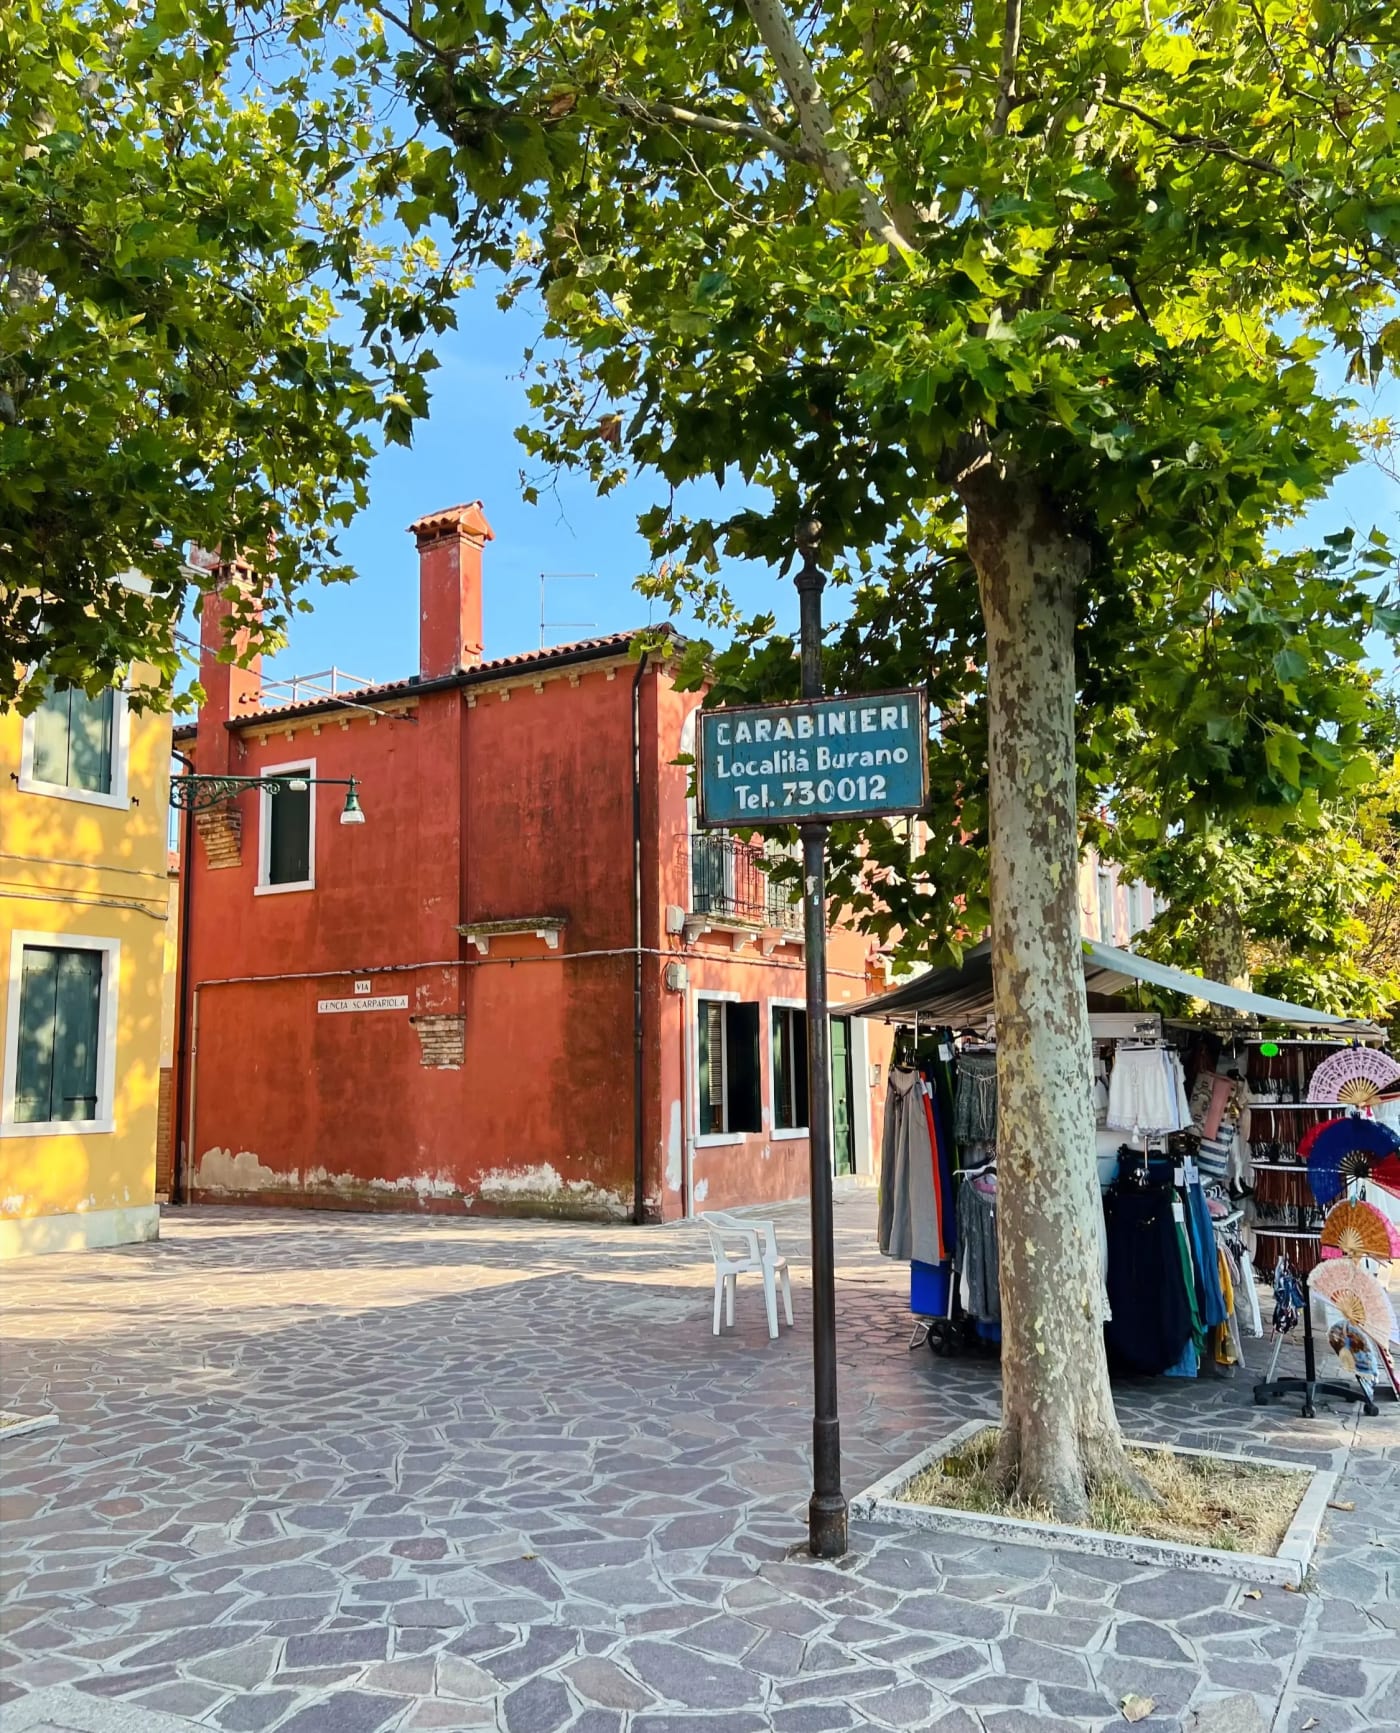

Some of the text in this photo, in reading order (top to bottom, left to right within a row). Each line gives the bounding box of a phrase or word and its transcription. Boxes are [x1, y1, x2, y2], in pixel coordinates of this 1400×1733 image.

[717, 705, 909, 745] CARABINIERI
[717, 746, 909, 778] Località Burano
[734, 775, 887, 809] Tel. 730012
[356, 983, 369, 991] VIA
